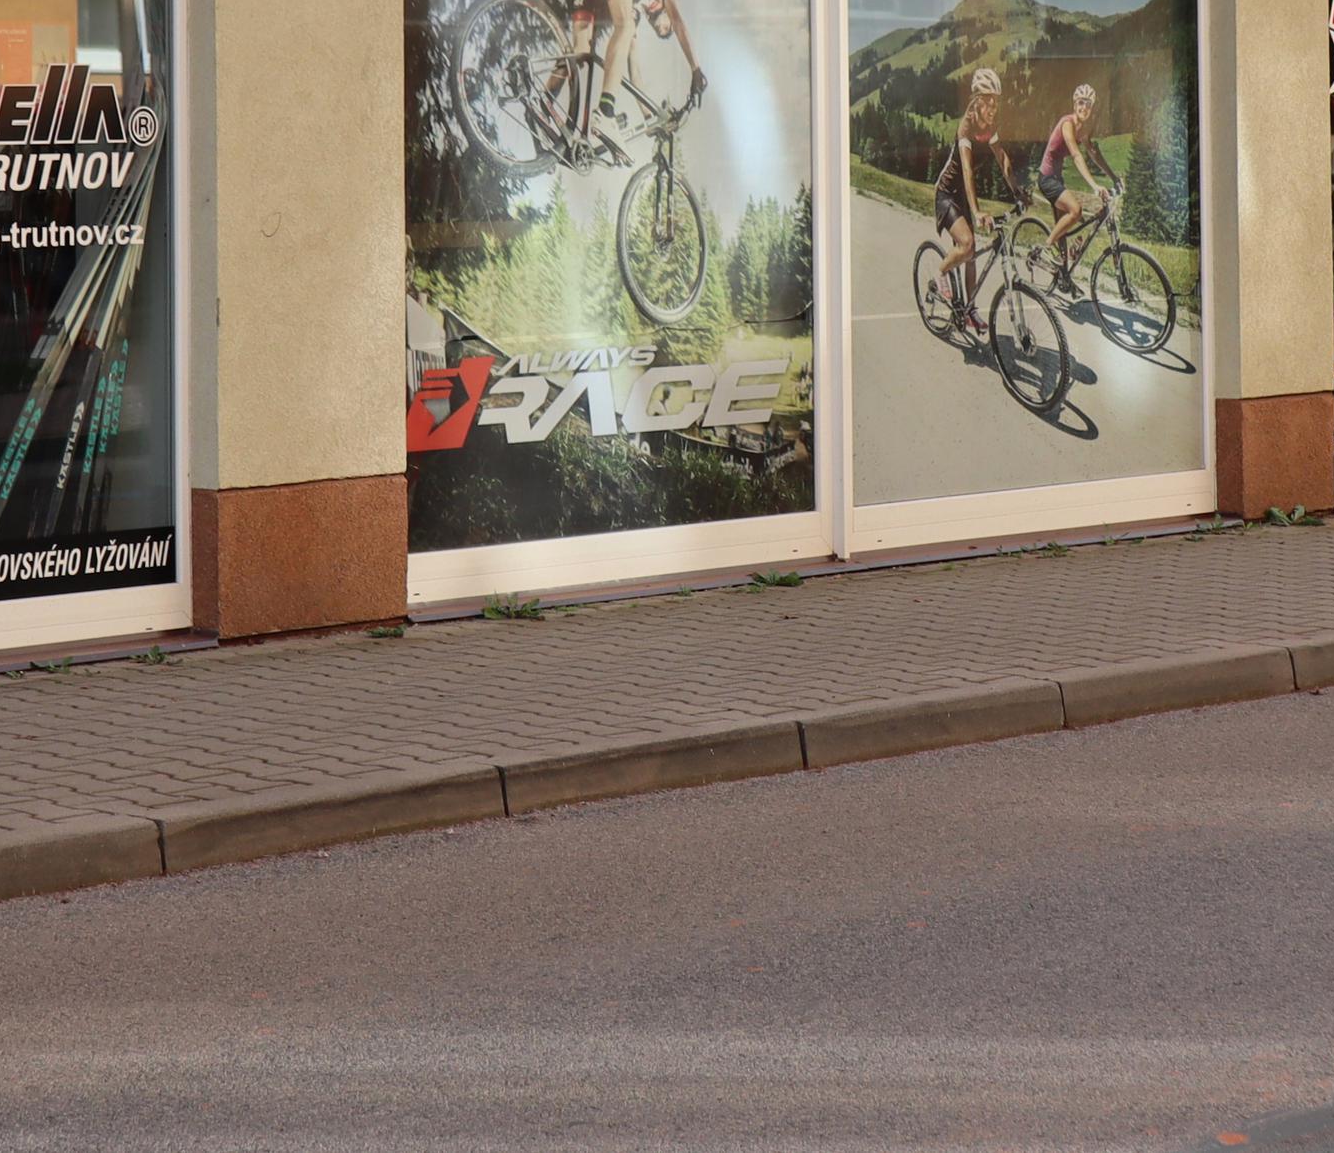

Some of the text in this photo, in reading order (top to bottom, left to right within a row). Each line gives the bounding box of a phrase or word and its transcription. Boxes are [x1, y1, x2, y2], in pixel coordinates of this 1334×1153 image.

[492, 345, 657, 376] ALWAYS
[477, 358, 790, 444] RACE
[85, 534, 172, 574] LYŽOVÁNÍ
